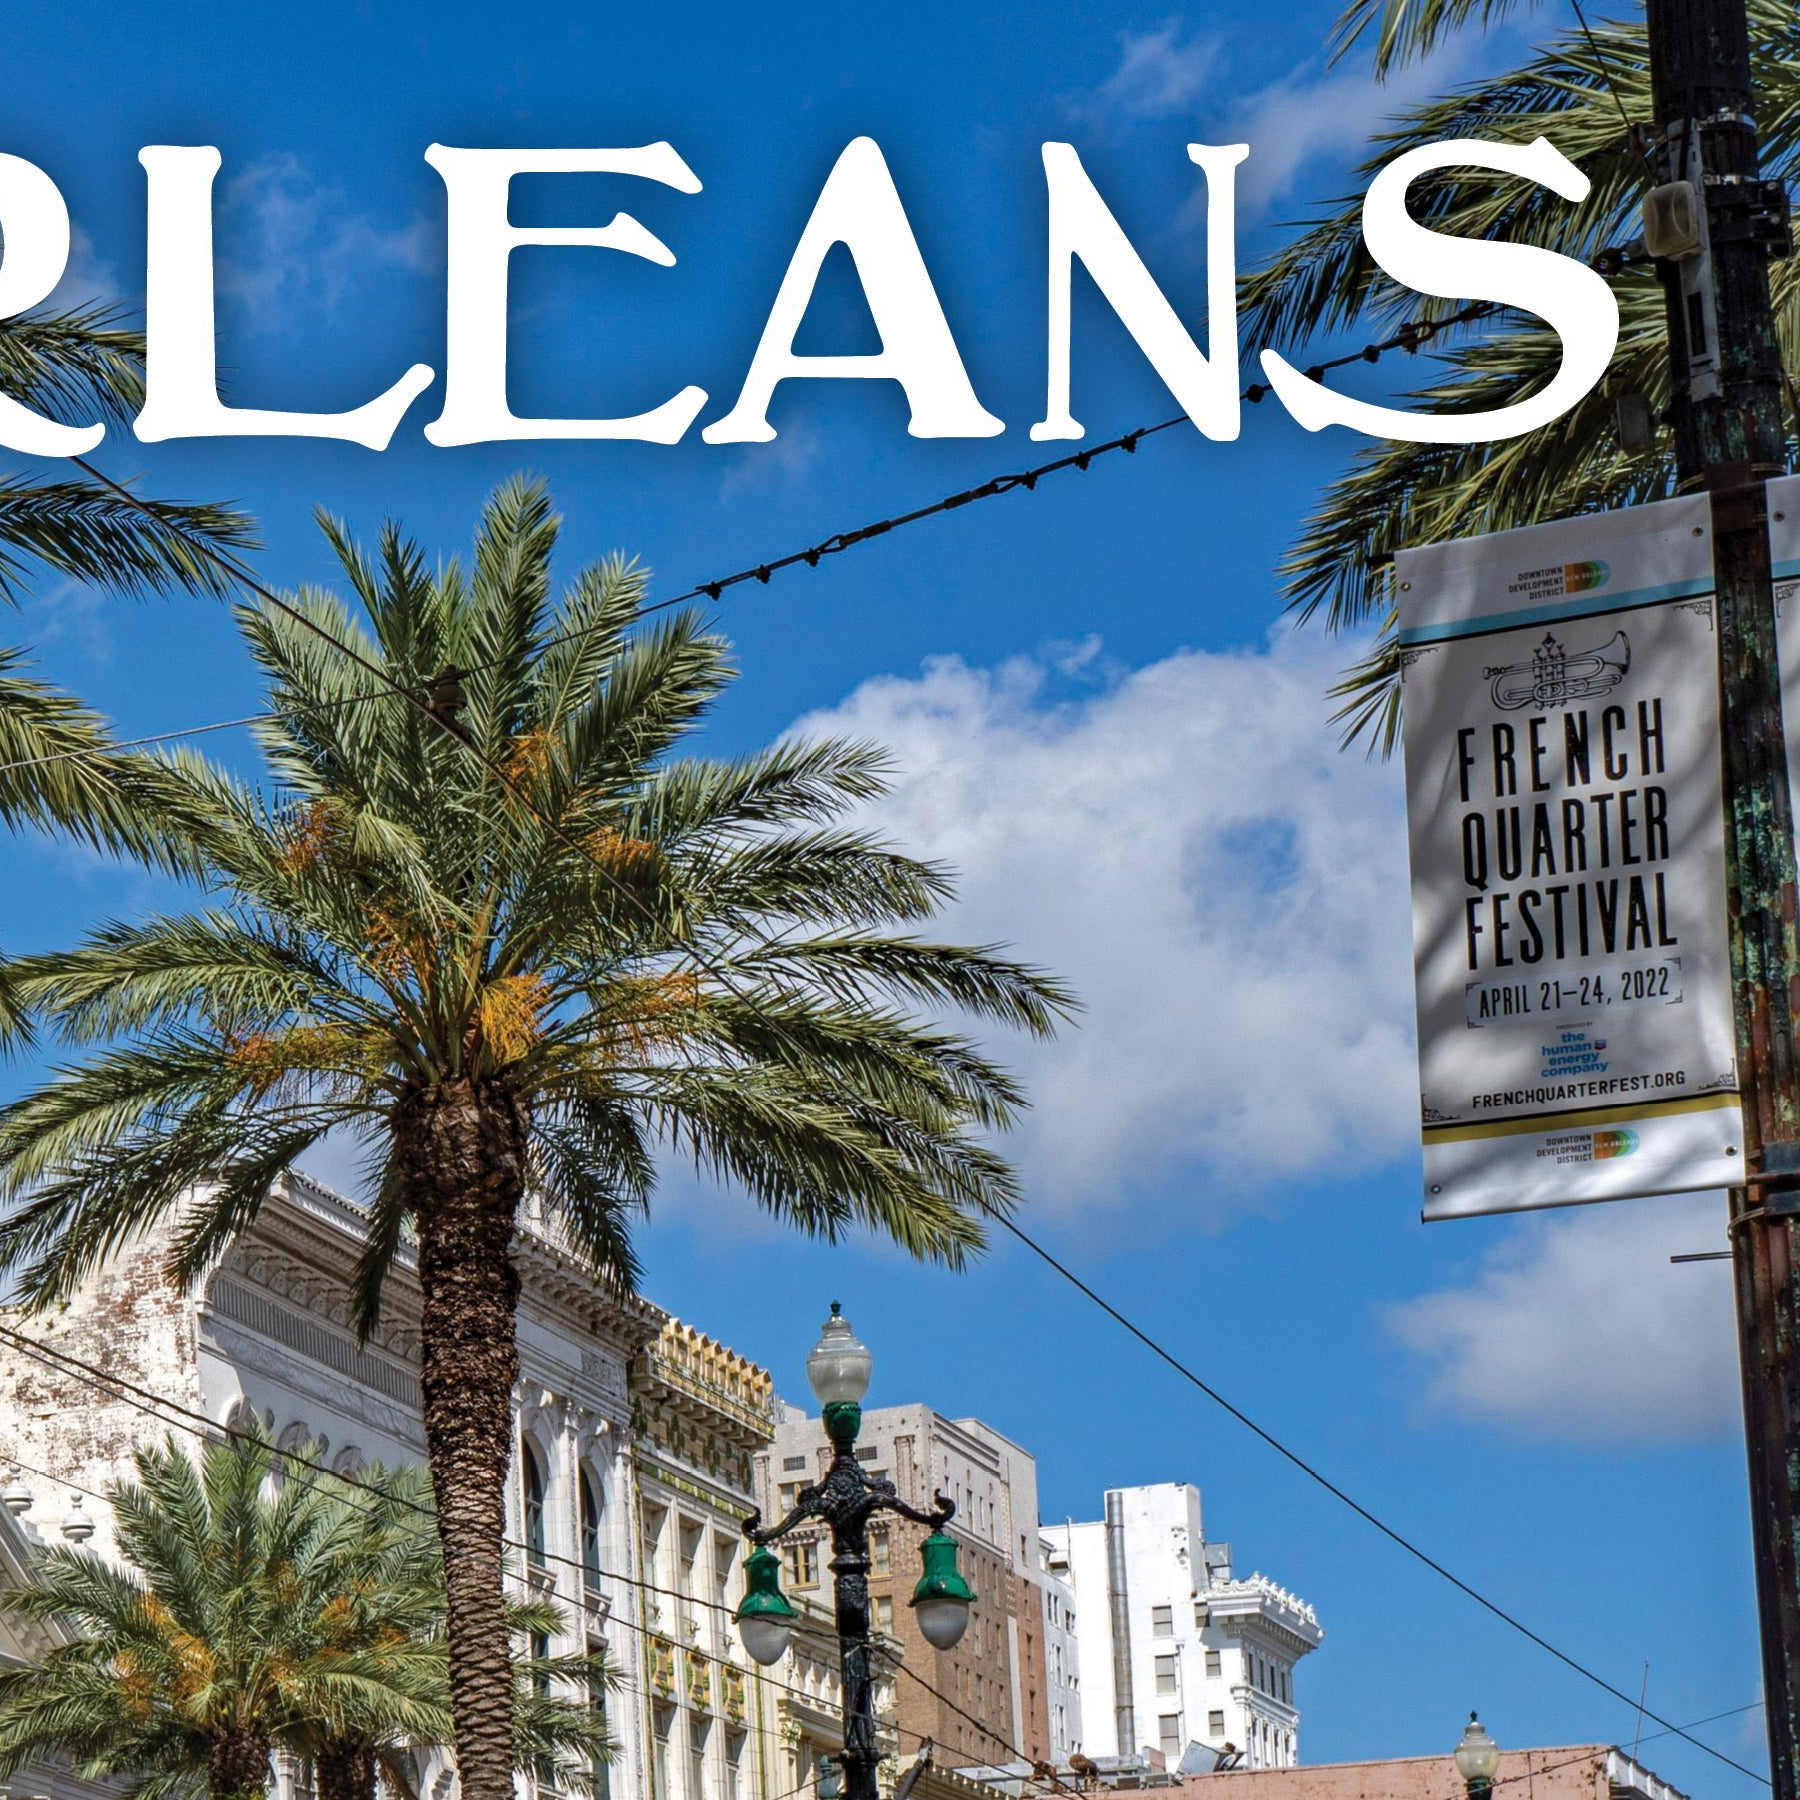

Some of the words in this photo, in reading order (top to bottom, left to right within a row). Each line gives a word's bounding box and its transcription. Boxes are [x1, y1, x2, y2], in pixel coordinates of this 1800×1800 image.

[1518, 567, 1563, 581] DOWNTOWN
[1509, 577, 1563, 593] DEVELOPMENT
[1529, 587, 1564, 600] DISTRICT
[1457, 698, 1665, 802] FRENCH
[1462, 786, 1669, 892] QUARTER
[1465, 872, 1678, 970] FESTIVAL
[1479, 984, 1531, 1018] APRIL
[1622, 967, 1669, 1001] 2022
[1561, 1032, 1585, 1043] the
[1542, 1041, 1592, 1056] human
[1549, 1052, 1600, 1066] energy
[1541, 1061, 1609, 1078] company
[1473, 1071, 1686, 1109] FRENCHQUARTERFEST.ORG
[1546, 1134, 1592, 1146] DOWNTOWN
[1536, 1144, 1592, 1157] DEVELOPMENT
[1557, 1154, 1592, 1164] DISTRICT
